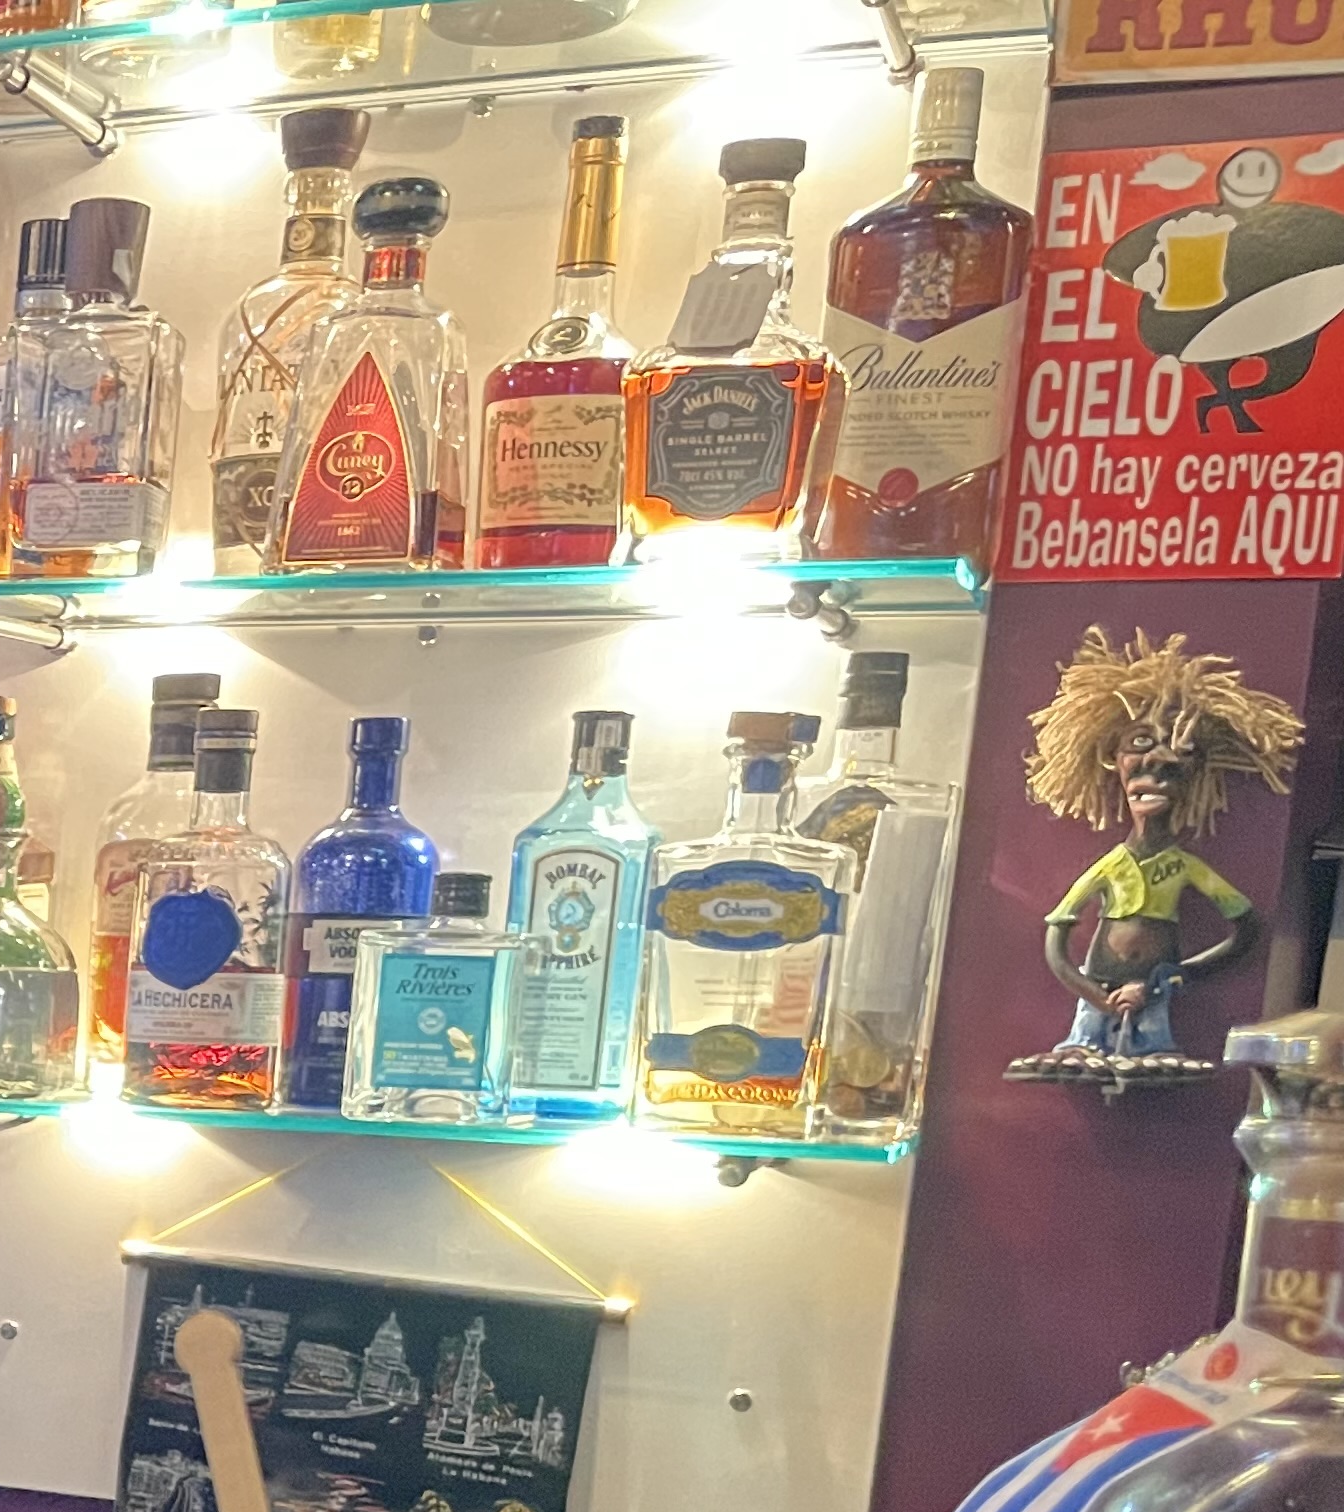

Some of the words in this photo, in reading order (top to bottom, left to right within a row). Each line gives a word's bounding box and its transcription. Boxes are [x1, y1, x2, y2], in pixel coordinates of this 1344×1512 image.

[1045, 172, 1121, 249] EN
[1040, 267, 1117, 343] EL
[839, 343, 1004, 394] Ballantine's
[875, 391, 946, 406] FINEST
[1025, 354, 1184, 440] CIELO
[849, 412, 885, 422] NDED
[501, 437, 609, 463] Hennessy
[1020, 443, 1079, 496] NO
[1090, 442, 1162, 510] hay
[1175, 450, 1344, 493] cerveza
[1011, 496, 1220, 570] Bebansela
[1229, 492, 1339, 576] AQUI
[544, 863, 607, 890] BOMBAY
[713, 900, 772, 918] Coloma
[324, 925, 359, 941] ABSO
[542, 944, 602, 970] PPHIRE
[412, 962, 460, 981] Trois
[144, 989, 234, 1011] HECHICERA
